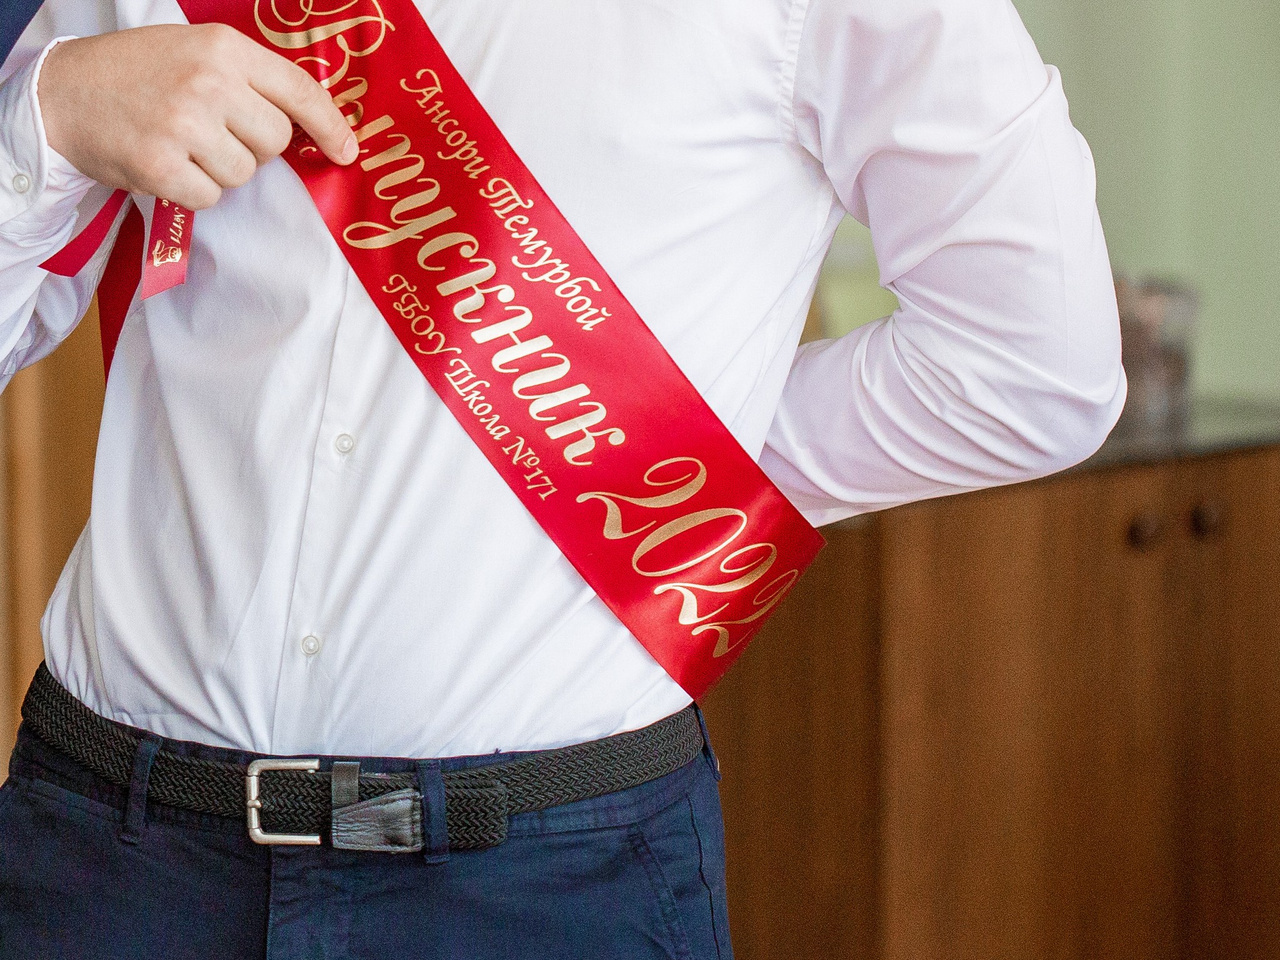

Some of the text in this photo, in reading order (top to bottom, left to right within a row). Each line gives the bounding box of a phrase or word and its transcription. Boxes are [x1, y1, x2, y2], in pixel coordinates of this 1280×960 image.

[399, 68, 612, 331] Ансори Темурбой
[382, 274, 558, 501] ГБОУ Школа №171
[576, 456, 798, 658] 2022
